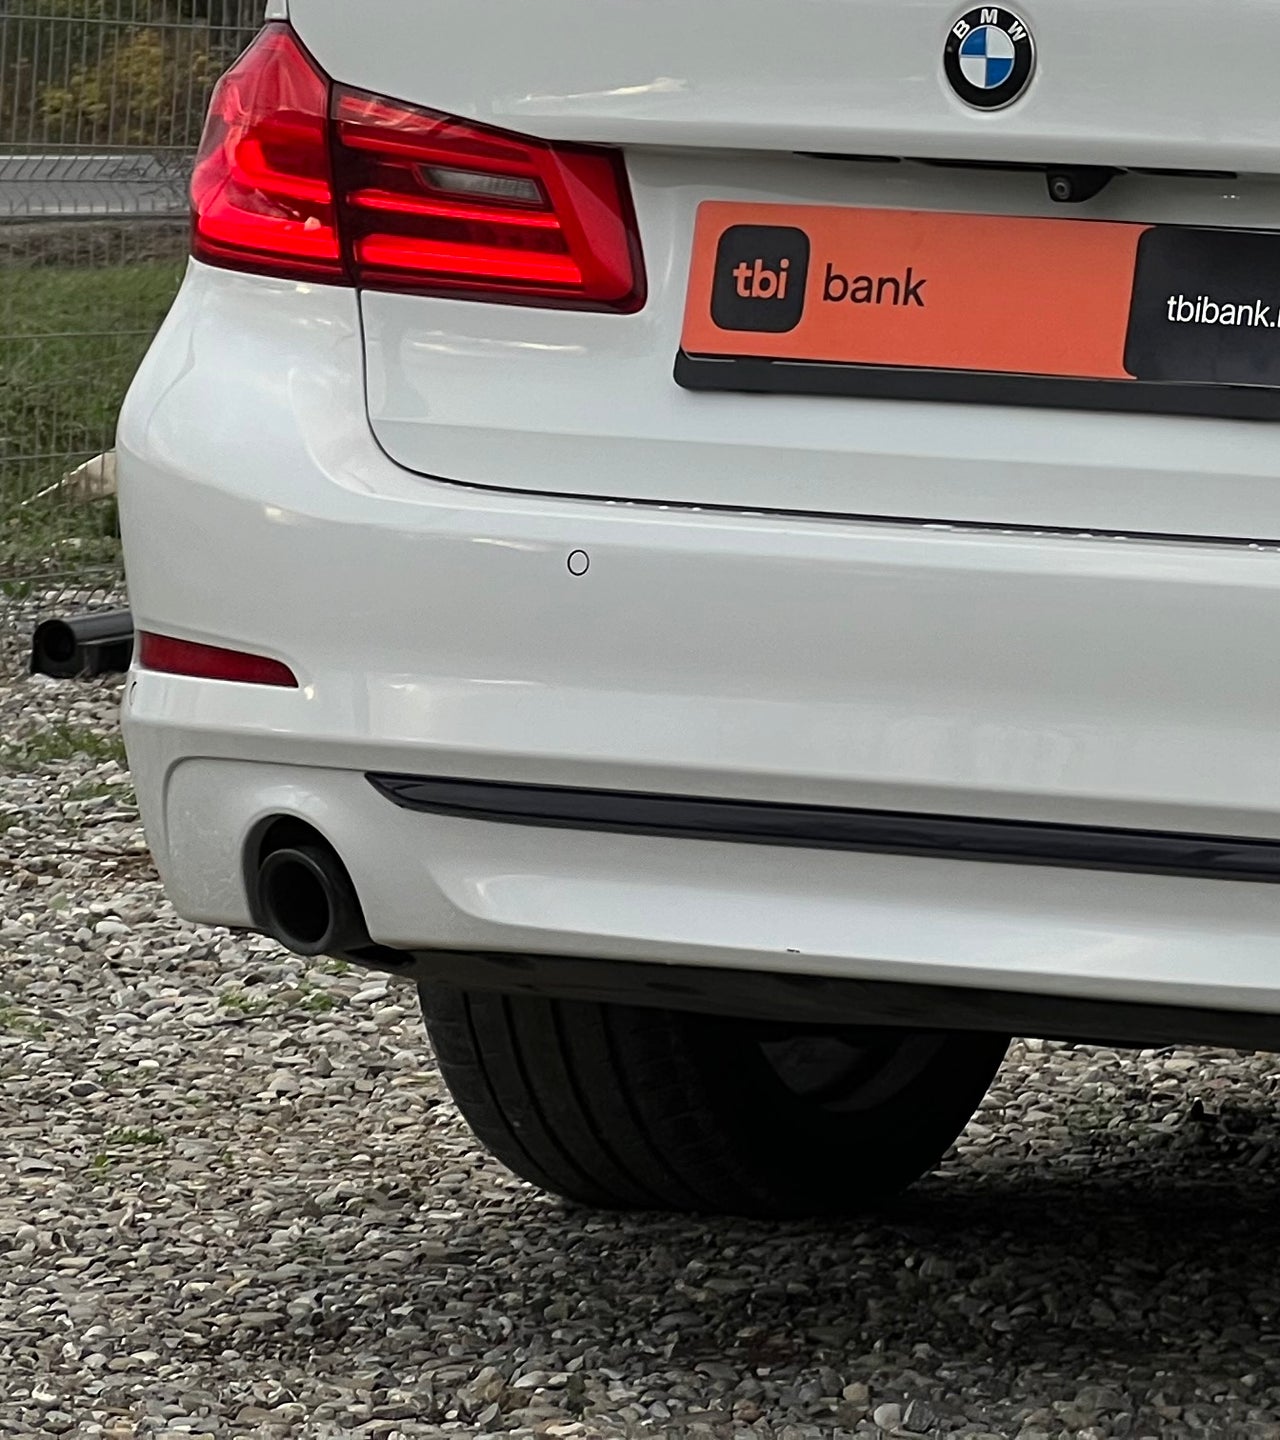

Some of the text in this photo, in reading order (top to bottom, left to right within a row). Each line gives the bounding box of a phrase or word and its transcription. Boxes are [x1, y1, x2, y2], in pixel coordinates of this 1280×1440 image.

[953, 8, 1027, 41] BMW
[733, 260, 927, 307] tbi bank
